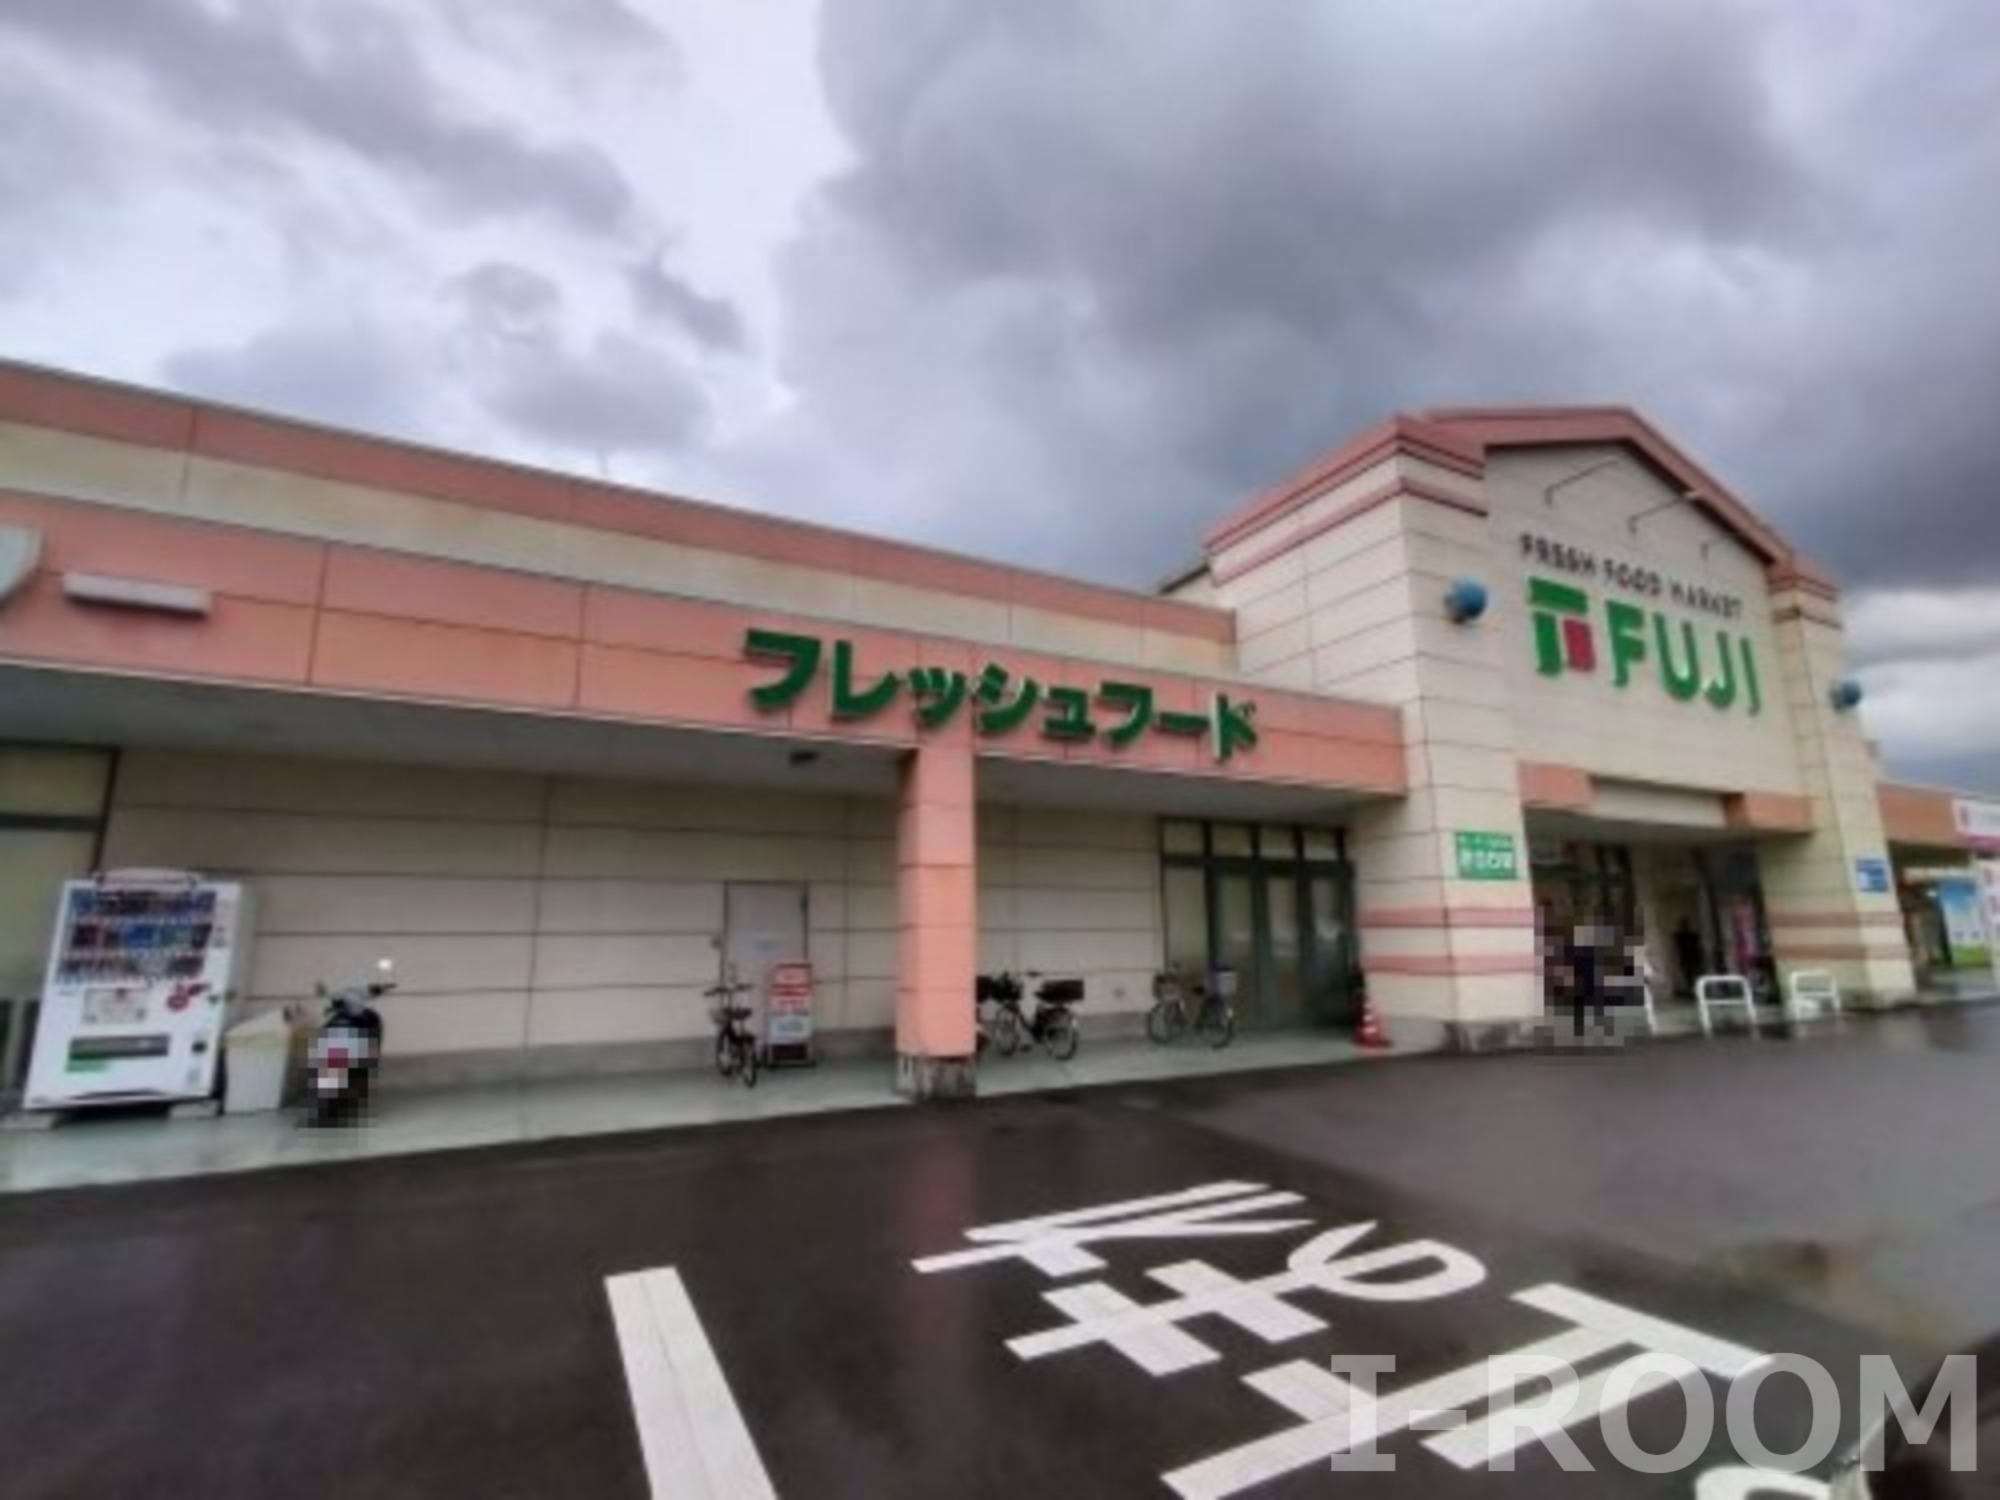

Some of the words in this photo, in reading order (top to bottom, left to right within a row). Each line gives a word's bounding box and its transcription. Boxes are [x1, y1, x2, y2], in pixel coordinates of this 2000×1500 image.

[1520, 533, 1597, 575] FRESH
[1604, 560, 1661, 597] FOOD
[745, 627, 1258, 761] フレッシュフード
[1607, 600, 1760, 716] FUJI
